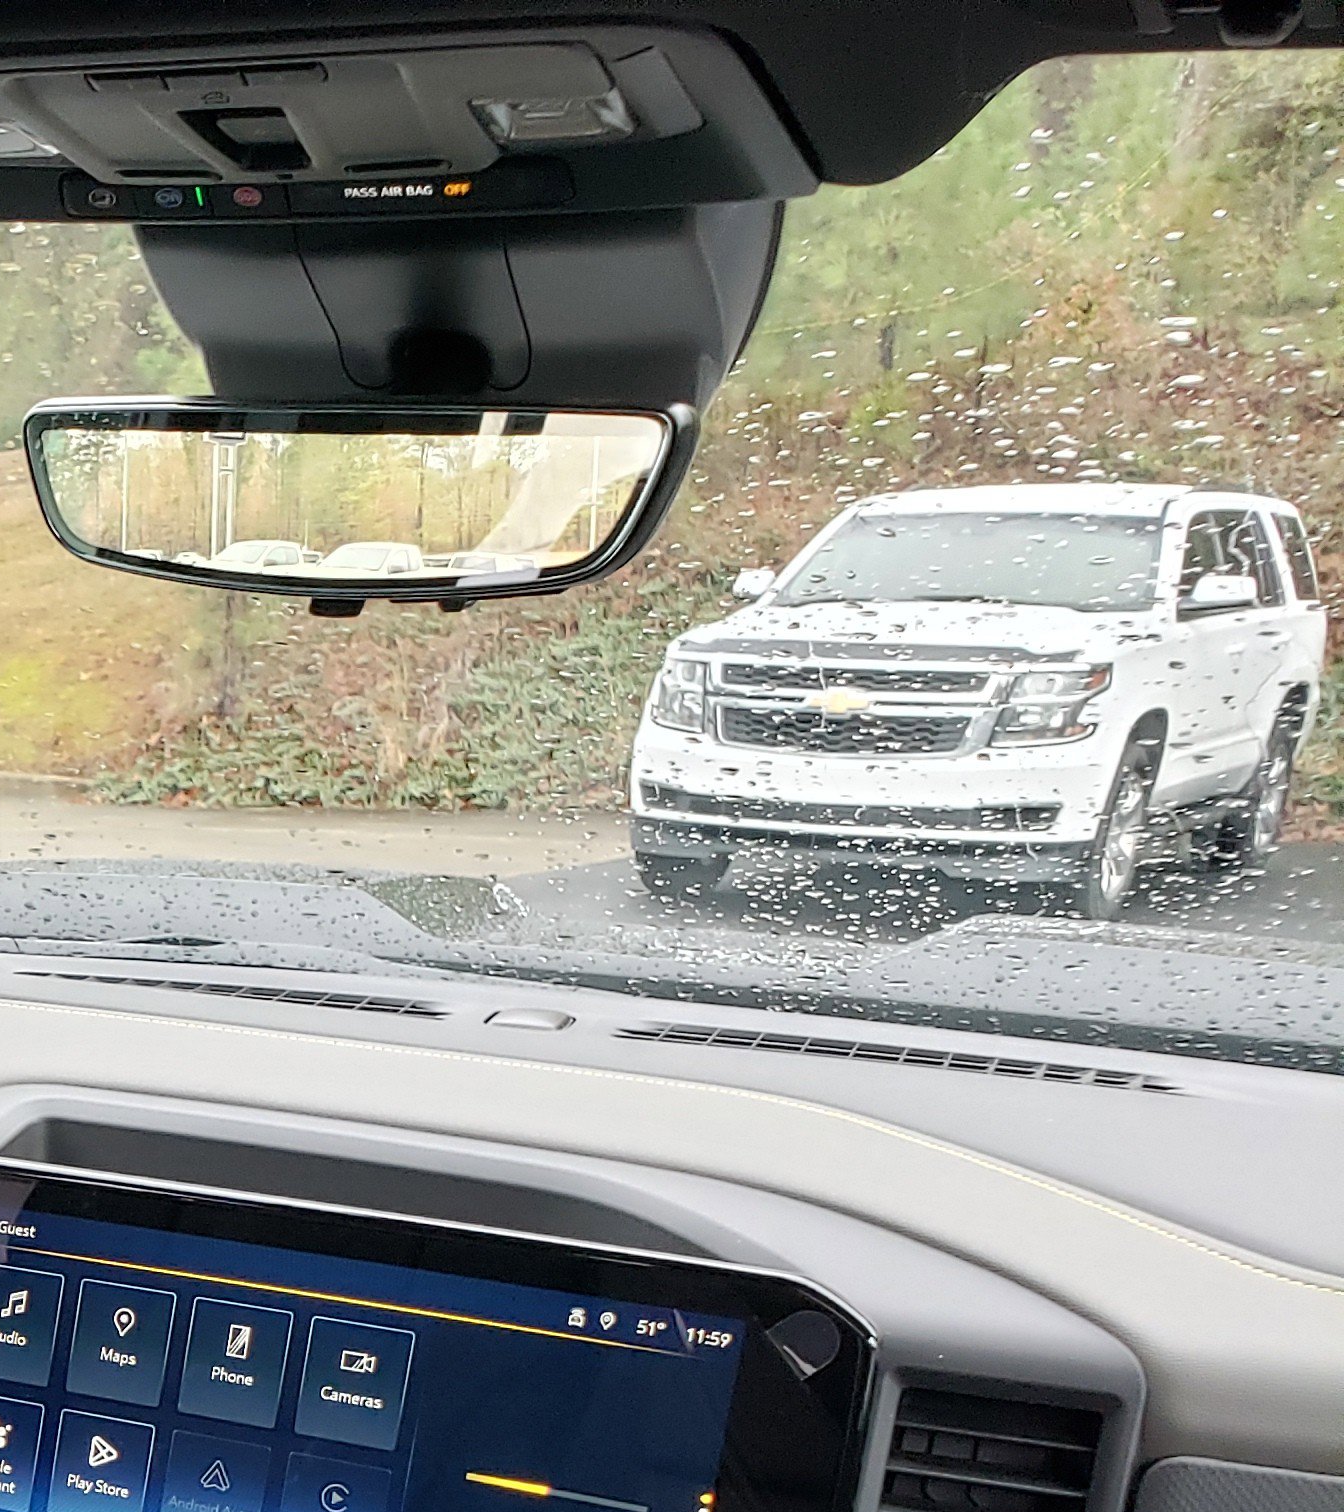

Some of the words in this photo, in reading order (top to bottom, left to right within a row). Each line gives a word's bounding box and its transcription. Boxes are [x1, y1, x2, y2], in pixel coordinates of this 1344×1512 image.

[344, 186, 377, 198] PASS
[381, 185, 403, 197] AIR
[406, 184, 433, 197] BAG
[443, 181, 472, 196] OFF
[636, 1318, 667, 1338] 51°
[685, 1327, 733, 1349] 11:59
[99, 1346, 137, 1368] Maps
[211, 1367, 254, 1387] Phone
[320, 1386, 383, 1410] Cameras
[67, 1474, 94, 1495] Play
[96, 1478, 129, 1499] Store
